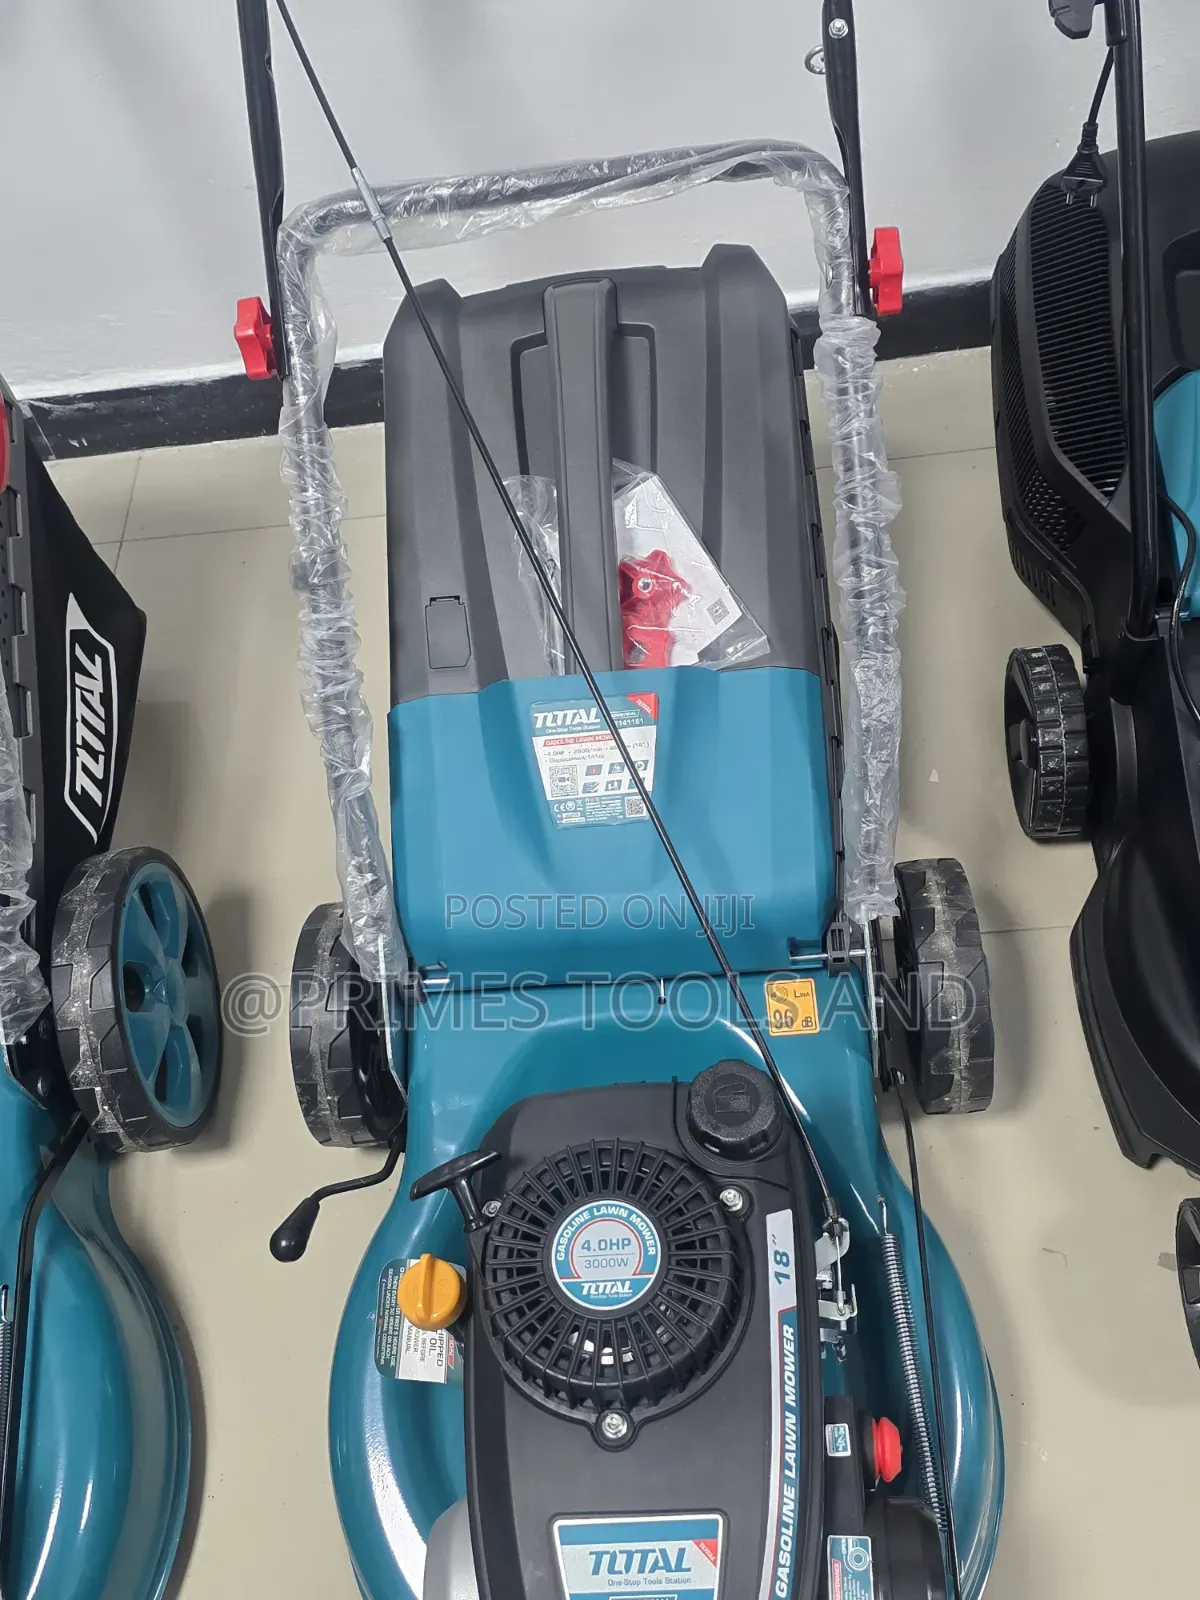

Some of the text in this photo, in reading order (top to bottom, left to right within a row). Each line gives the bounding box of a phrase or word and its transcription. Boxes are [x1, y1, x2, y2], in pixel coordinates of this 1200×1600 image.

[533, 707, 600, 728] TOTAL
[635, 699, 653, 715] TOTAL
[74, 642, 105, 808] TOTAL
[545, 733, 613, 746] GASOLINE LAWN MOW
[773, 1008, 813, 1030] 96 dB
[557, 1206, 656, 1261] GASOLINE LAWN MOWER
[581, 1237, 631, 1252] 4.0HP
[584, 1257, 629, 1269] 3000W
[581, 1281, 632, 1295] TOTAL
[775, 1324, 797, 1599] GASOLINE LAWN MOWER
[589, 1547, 692, 1576] TOTAL
[699, 1541, 717, 1562] TOTAL
[607, 1576, 692, 1587] One-Stop Tools Station
